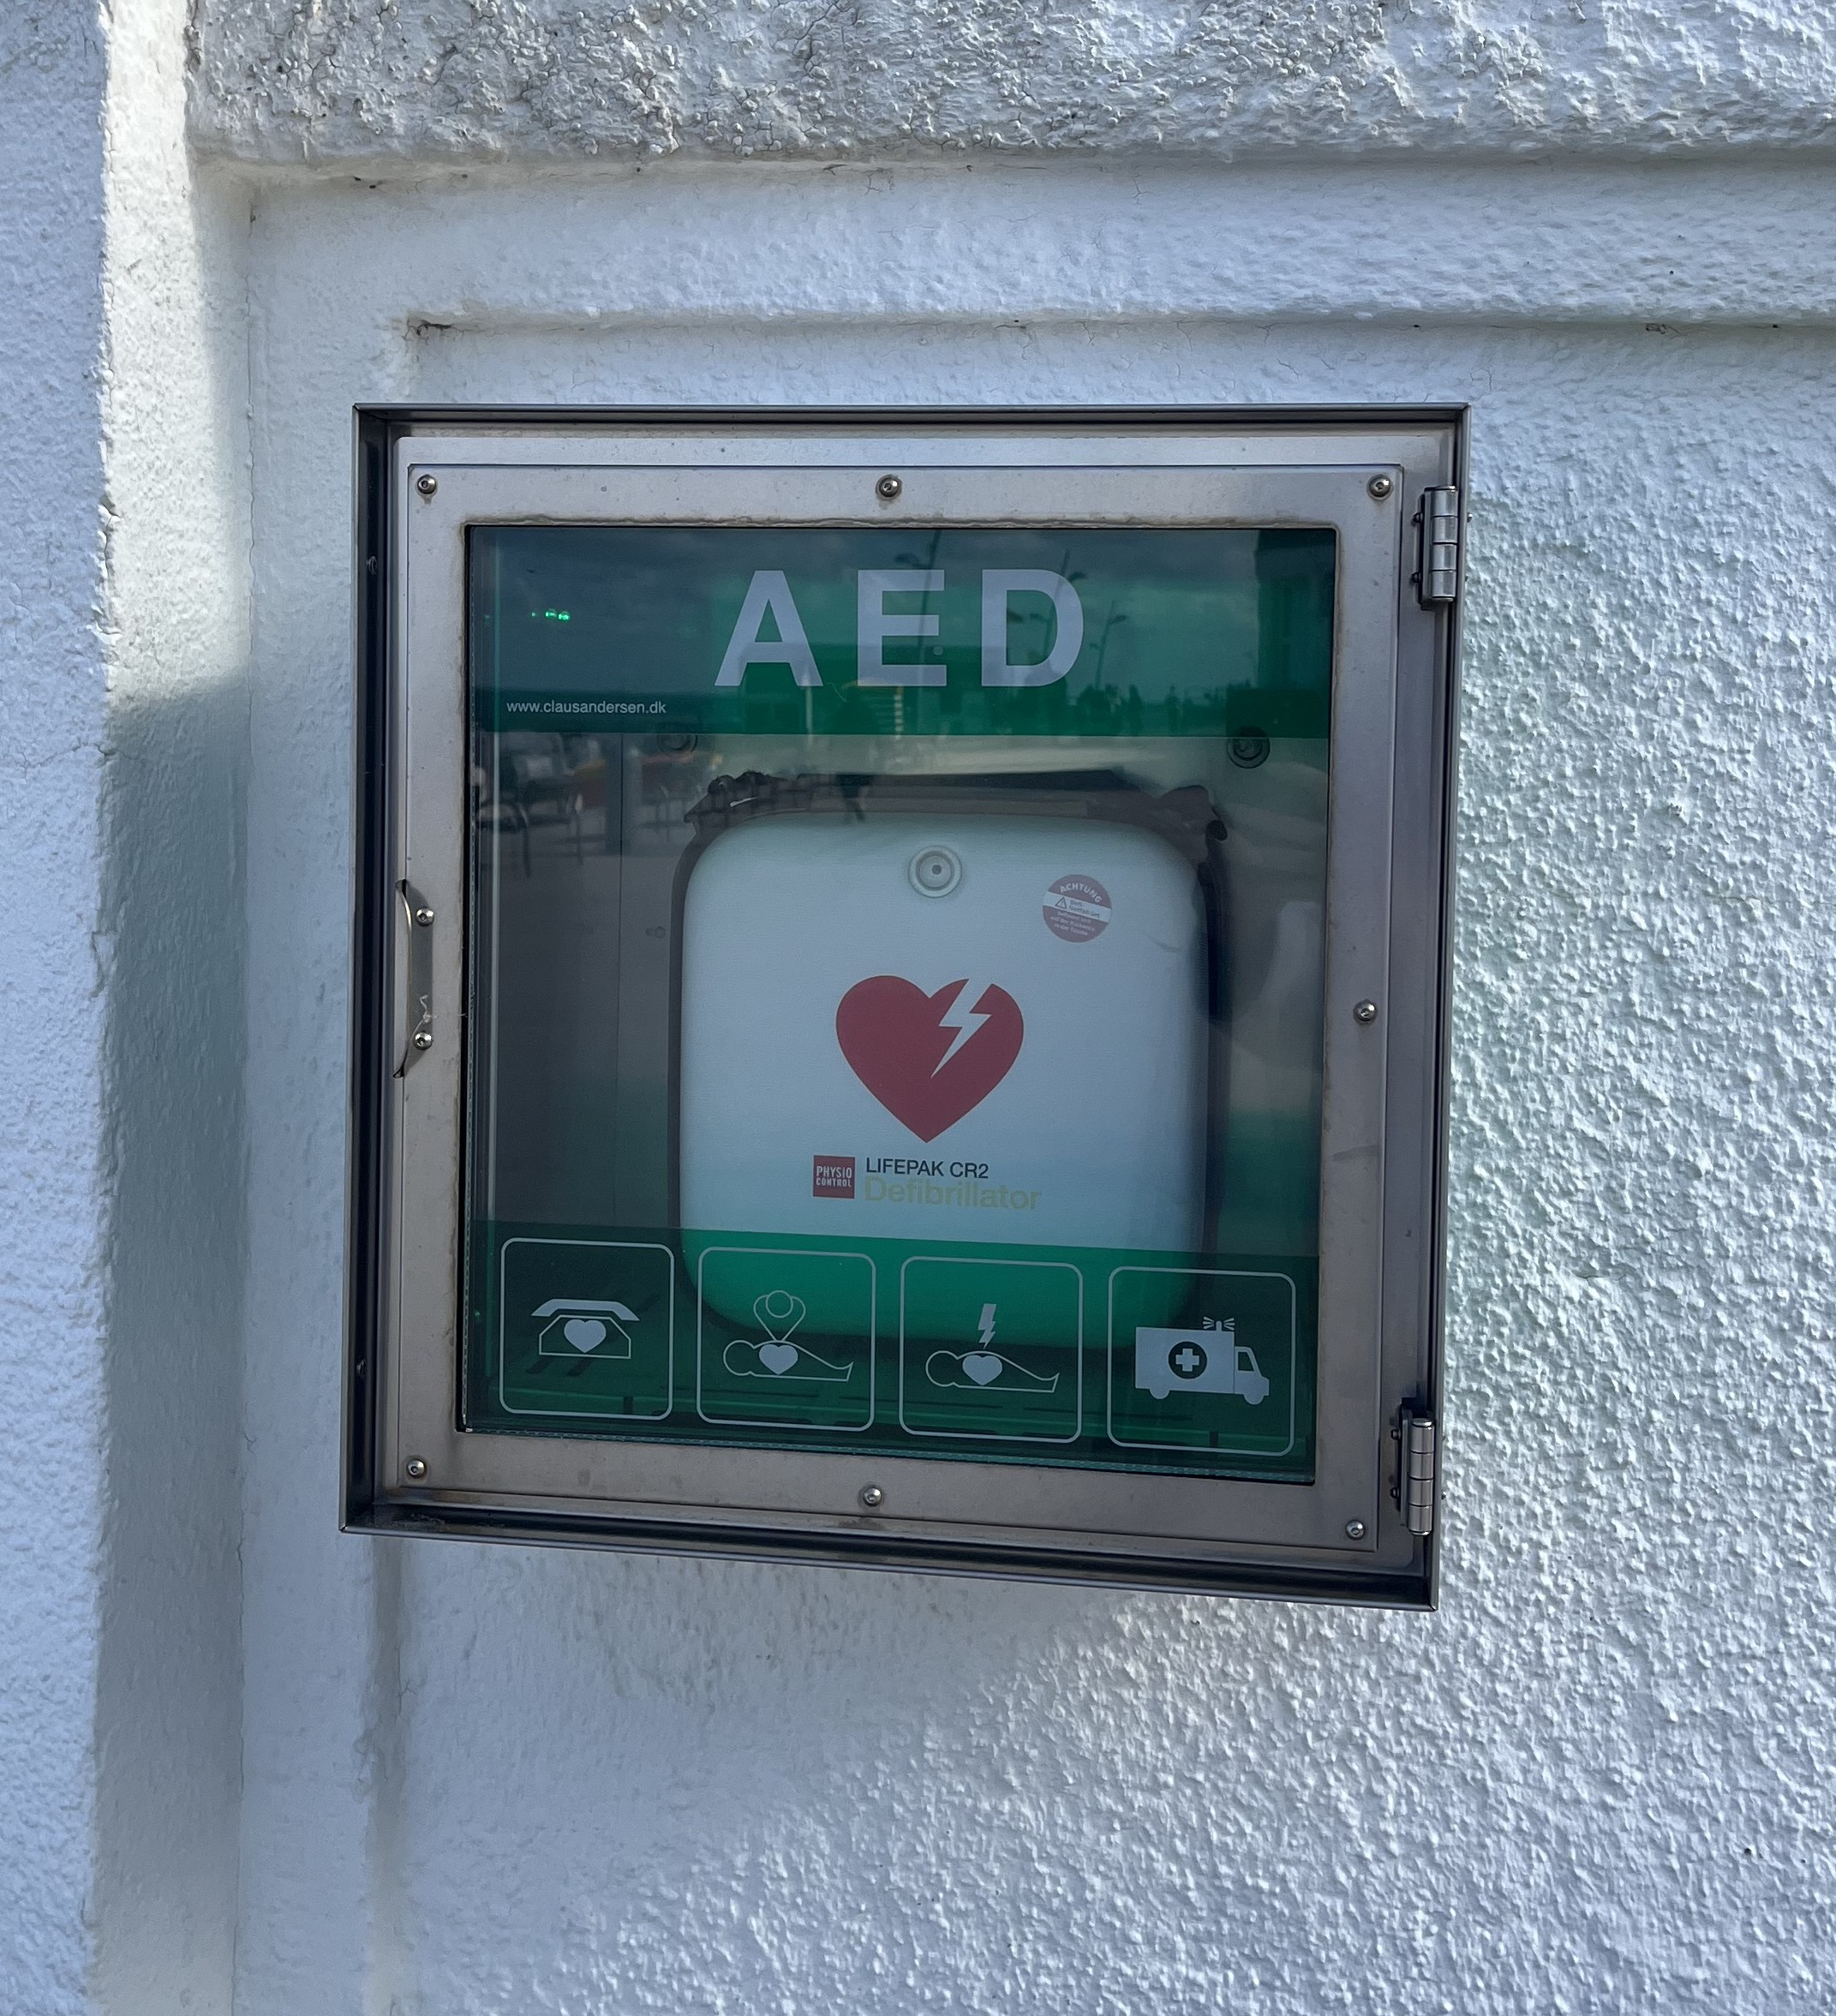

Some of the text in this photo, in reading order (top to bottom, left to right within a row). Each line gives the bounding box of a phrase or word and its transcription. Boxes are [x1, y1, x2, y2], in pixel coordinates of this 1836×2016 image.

[714, 569, 1085, 687] AED
[506, 699, 667, 714] www.clausandersen.dk
[1060, 882, 1103, 903] ACHTUNG
[816, 1165, 852, 1179] PHYSIO
[866, 1157, 989, 1179] LIFEPAK CR2
[816, 1177, 852, 1187] CONTROL
[864, 1176, 1043, 1210] Defibrillator
